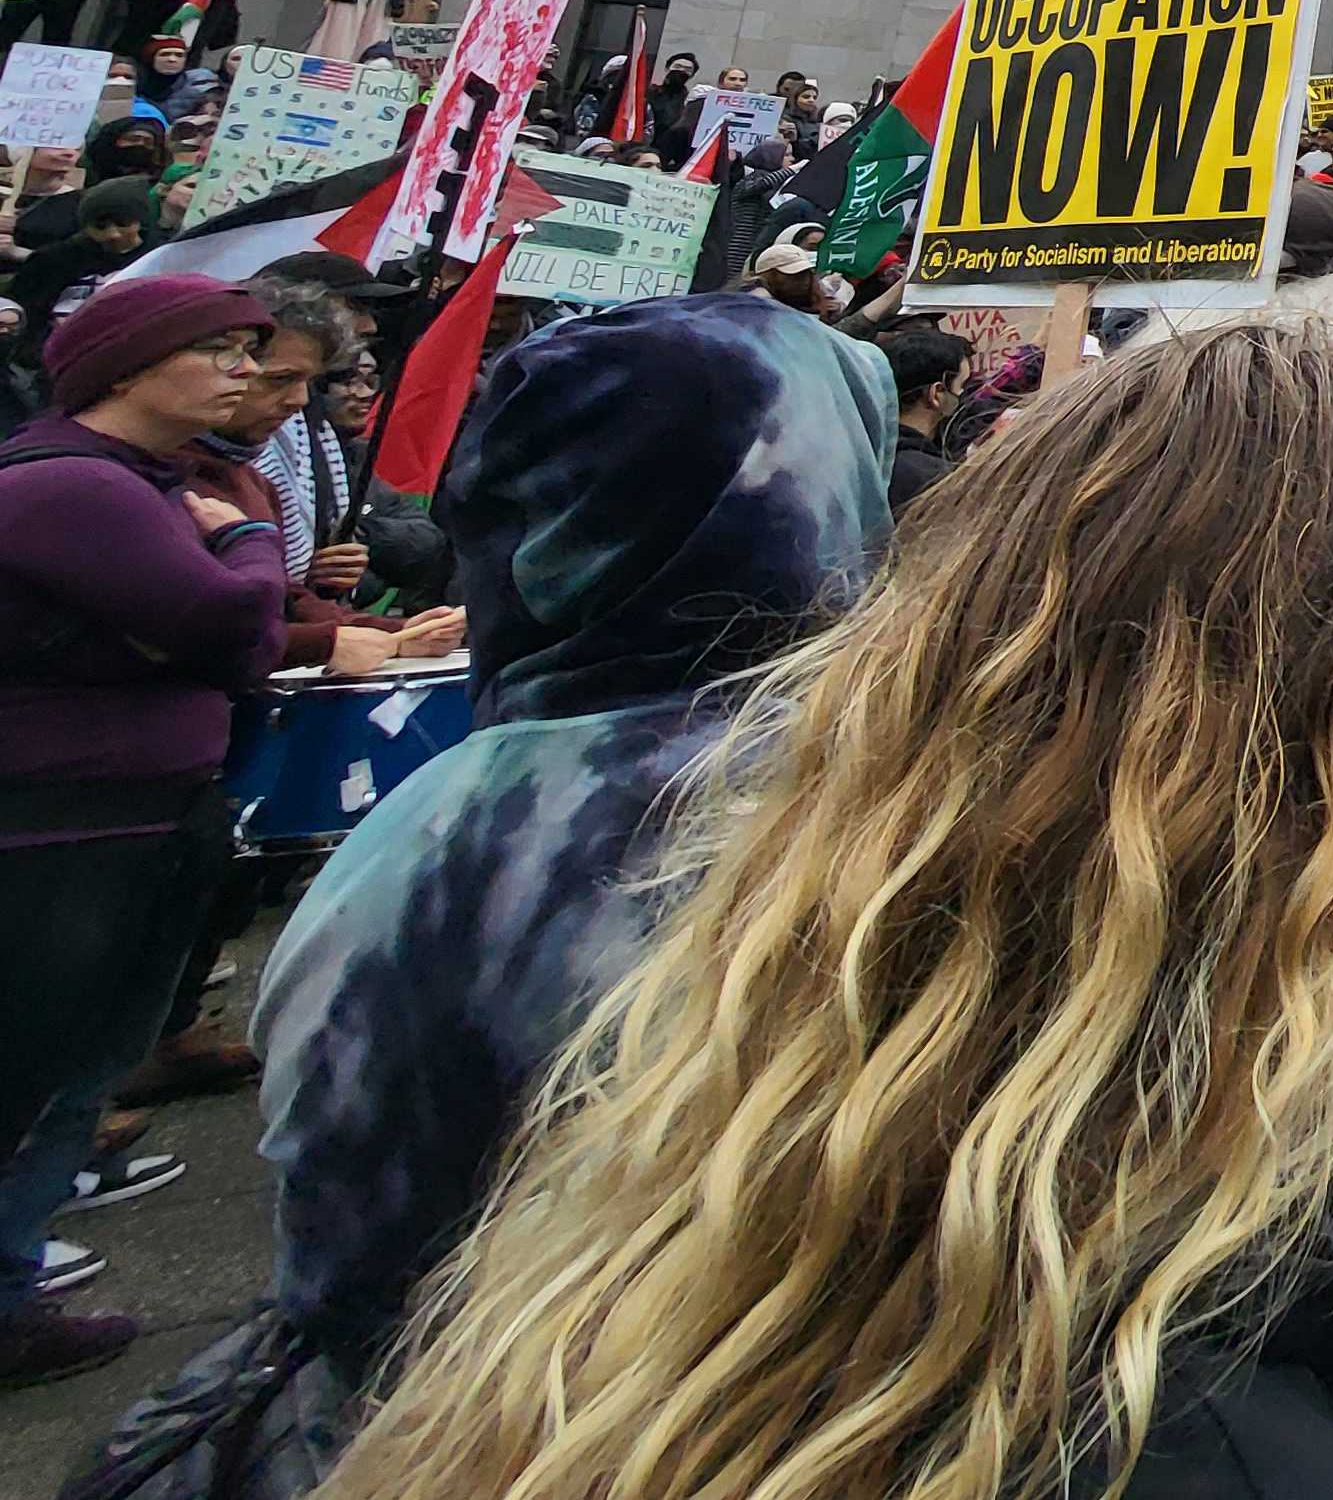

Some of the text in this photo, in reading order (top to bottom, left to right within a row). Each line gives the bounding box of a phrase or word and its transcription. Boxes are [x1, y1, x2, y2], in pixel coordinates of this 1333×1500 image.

[32, 72, 78, 91] FOR
[251, 38, 295, 79] US
[356, 68, 410, 102] Funds
[716, 96, 776, 112] FREE FREE
[938, 24, 1272, 226] NOW!
[573, 201, 692, 239] PALESTINE
[954, 238, 1256, 273] Party for Socialism and Liberation
[569, 260, 611, 291] BE
[619, 265, 689, 297] FREE
[949, 310, 1006, 331] VIVA
